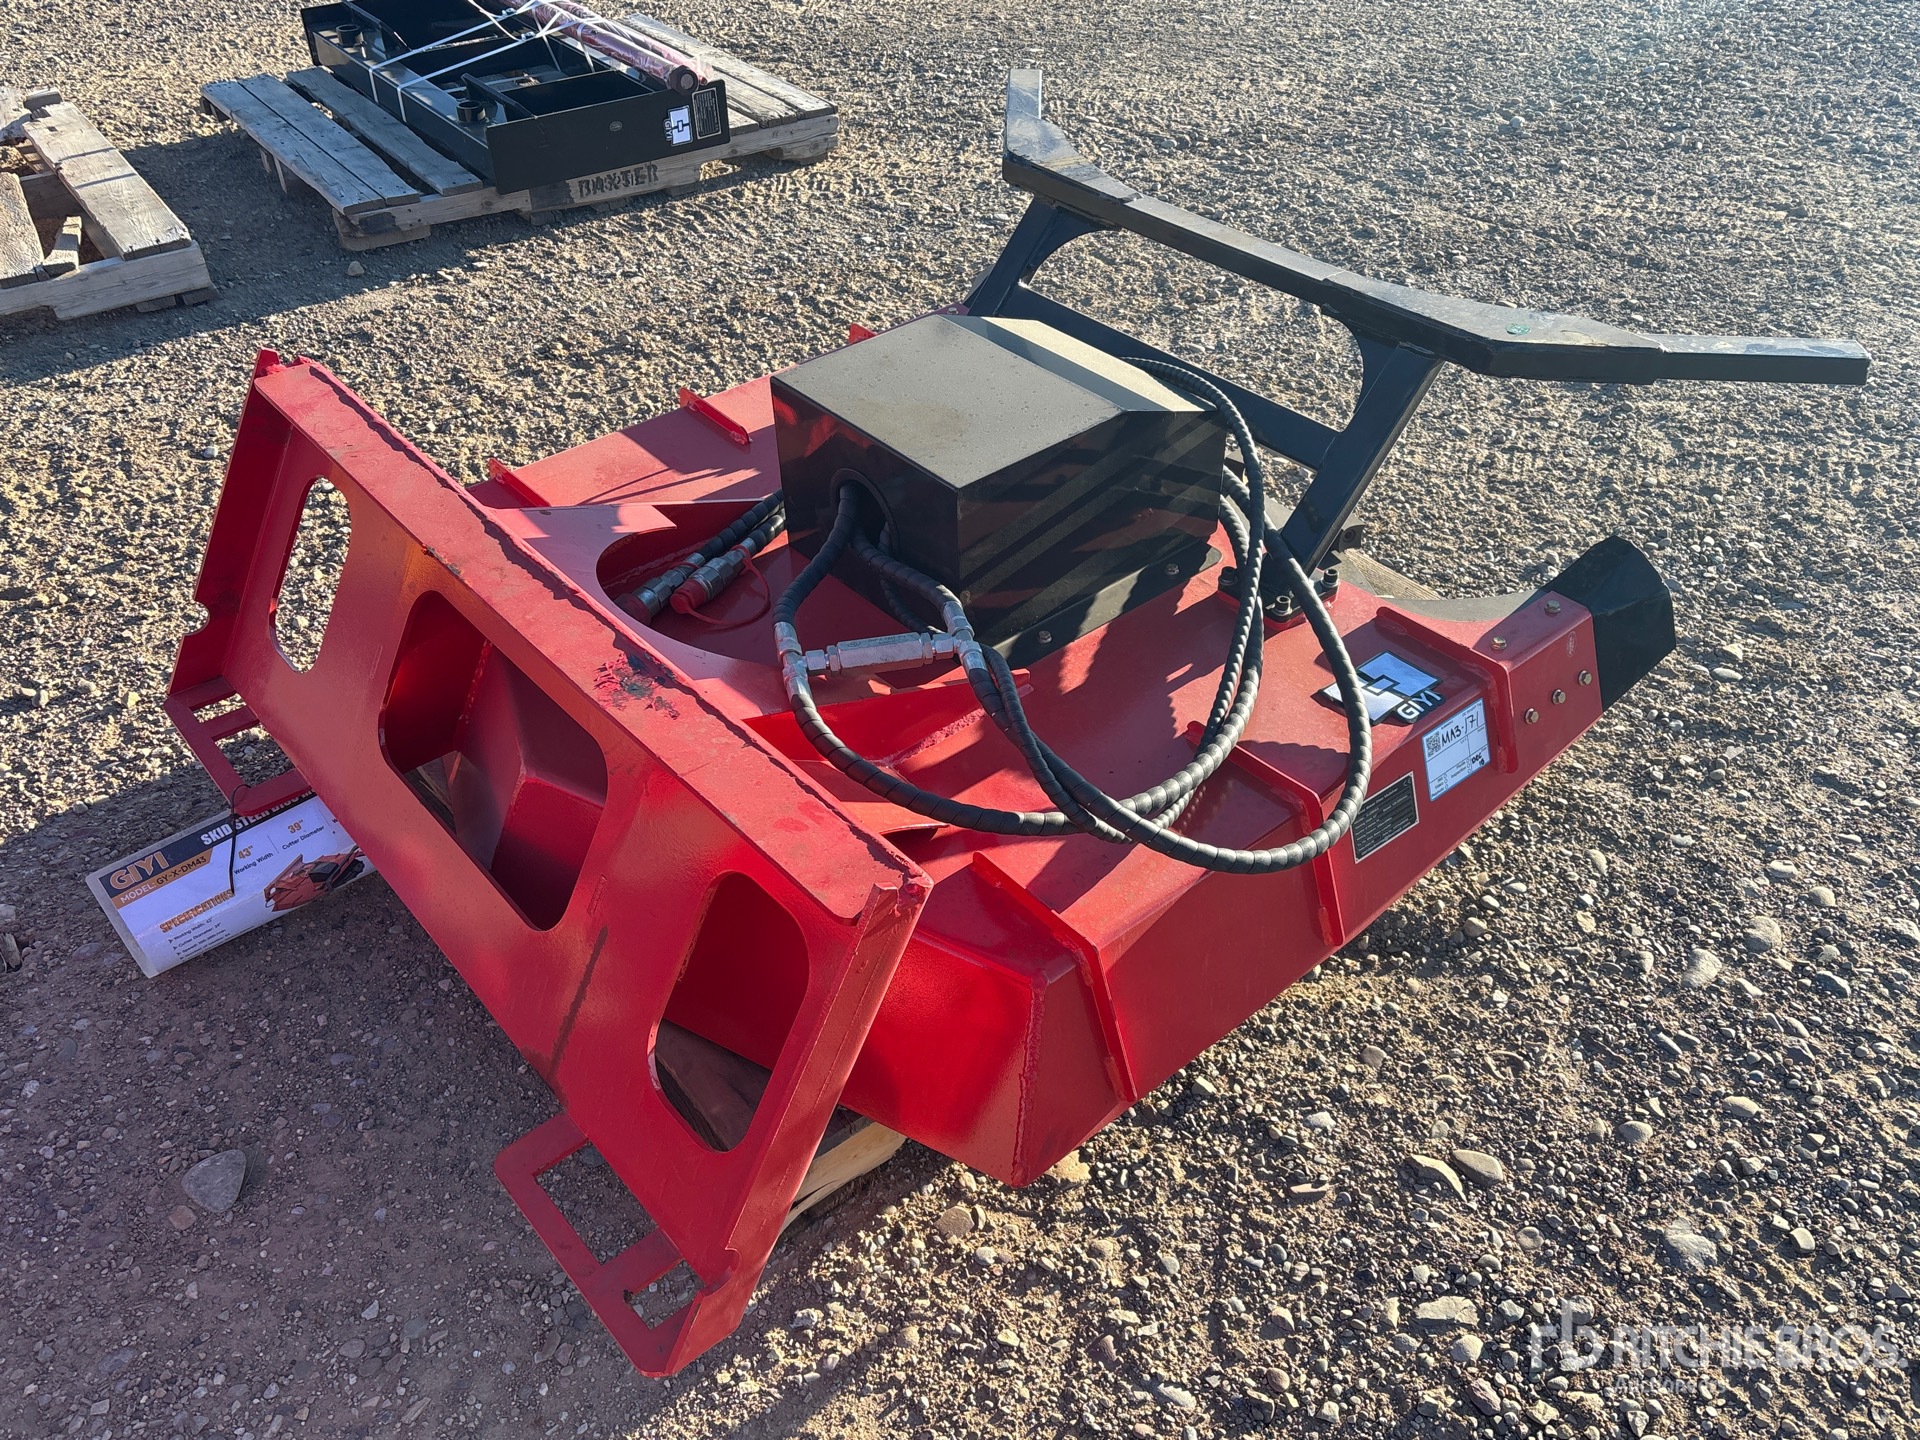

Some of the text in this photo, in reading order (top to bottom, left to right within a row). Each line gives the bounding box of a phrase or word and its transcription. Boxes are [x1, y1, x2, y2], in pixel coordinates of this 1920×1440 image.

[578, 163, 659, 198] BAXTER
[1397, 689, 1442, 719] GIYI
[200, 823, 233, 845] SKID
[282, 826, 324, 850] Cutter Diameter
[287, 819, 303, 834] 39"
[234, 852, 274, 875] Working Width
[238, 845, 253, 860] 43"
[110, 851, 170, 890] GIYI
[120, 856, 207, 904] MODEL: GY-X-DM43
